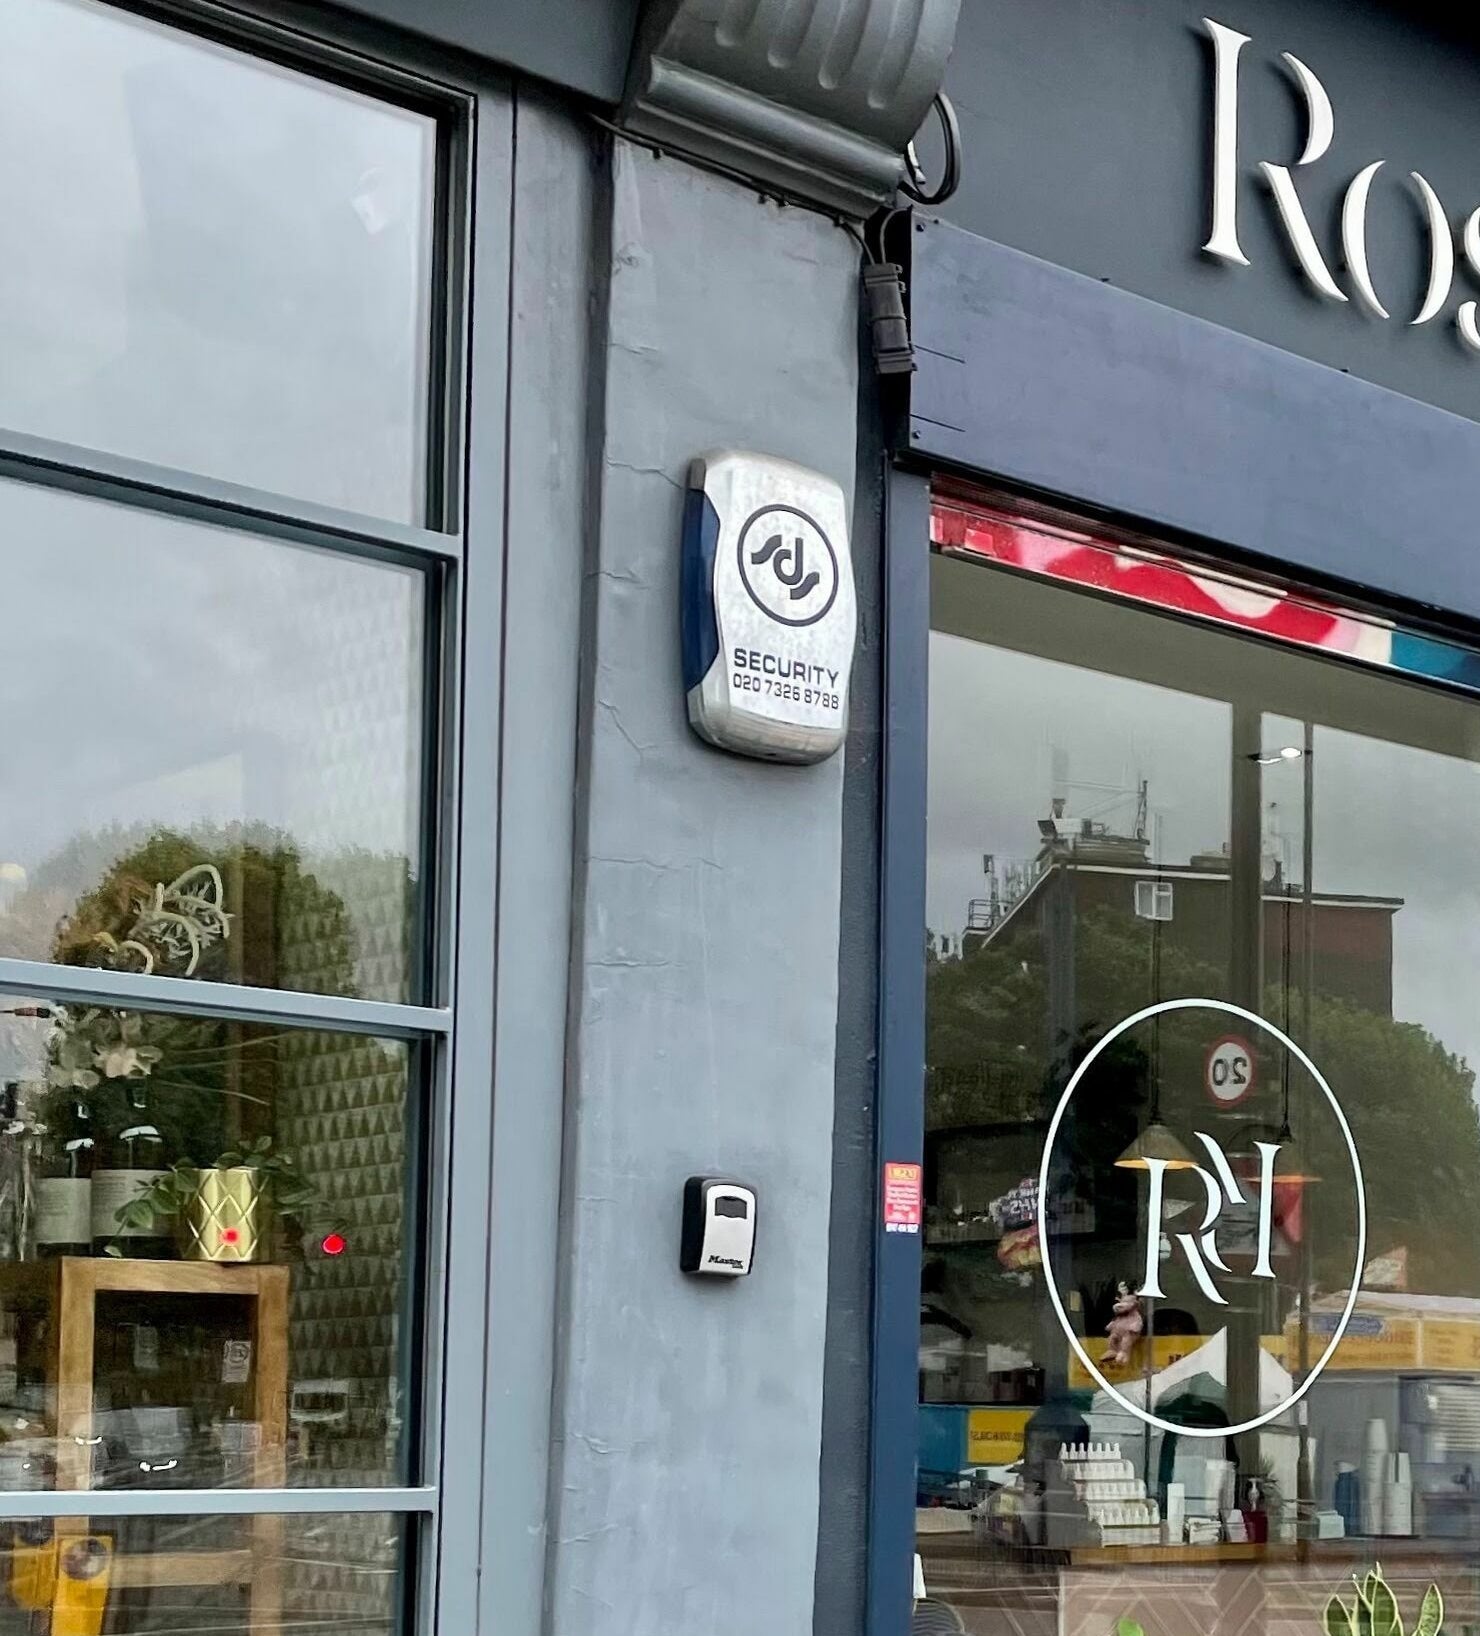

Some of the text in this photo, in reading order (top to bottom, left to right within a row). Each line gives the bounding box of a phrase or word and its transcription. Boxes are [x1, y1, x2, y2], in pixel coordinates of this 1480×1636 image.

[733, 648, 840, 689] SECURITY
[732, 672, 840, 711] 020 7326 8788
